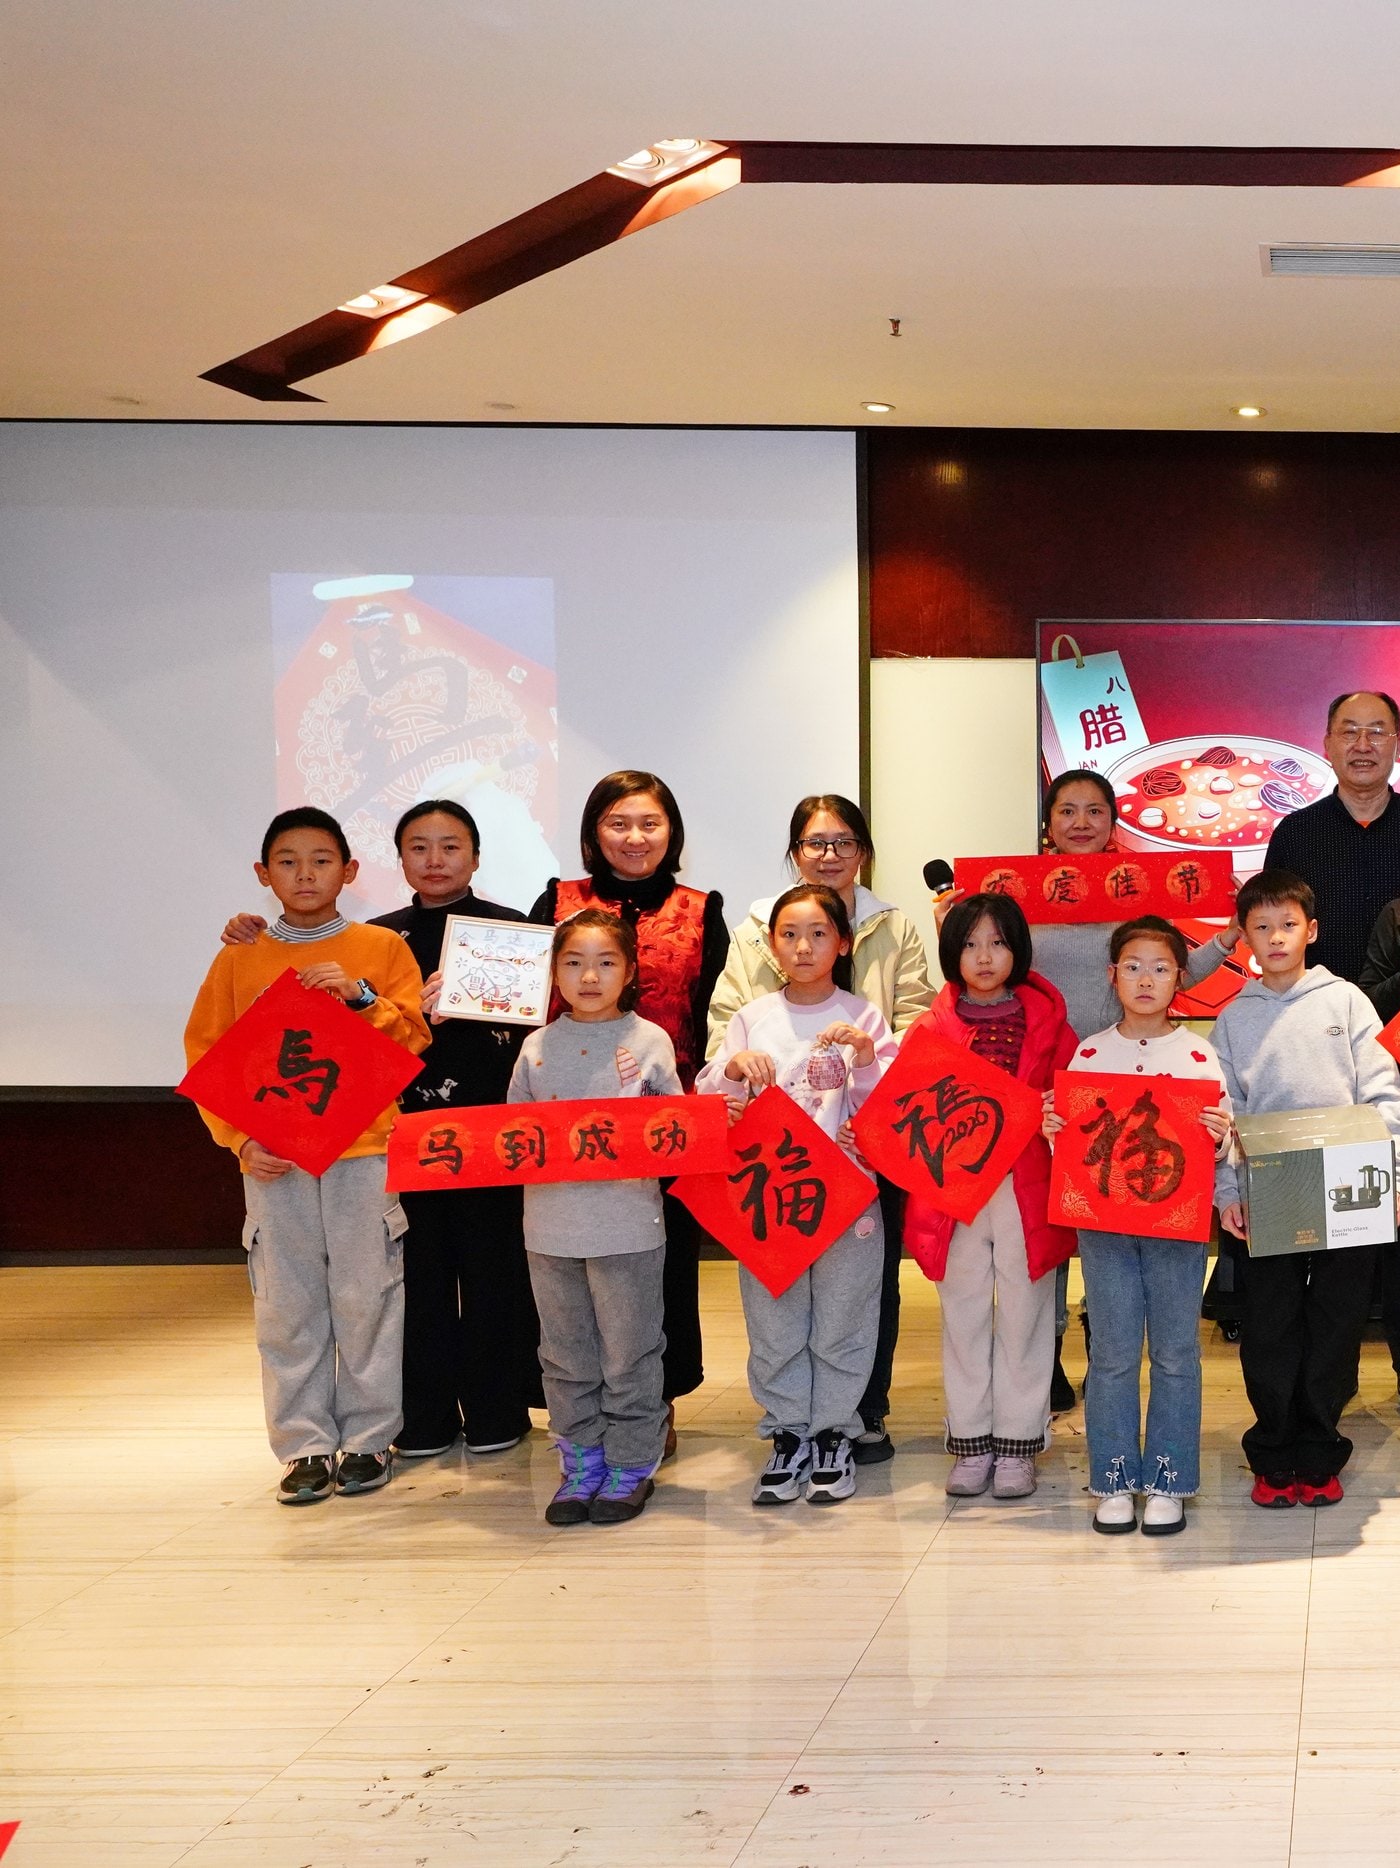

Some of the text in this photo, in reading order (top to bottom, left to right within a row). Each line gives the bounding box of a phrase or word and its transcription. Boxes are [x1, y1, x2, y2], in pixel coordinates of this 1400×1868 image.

[1106, 676, 1126, 694] 八
[1079, 703, 1127, 751] 腊
[418, 1119, 688, 1175] 马到成功
[944, 1102, 989, 1153] 2026
[1079, 1088, 1187, 1203] 福
[728, 1128, 828, 1242] 福
